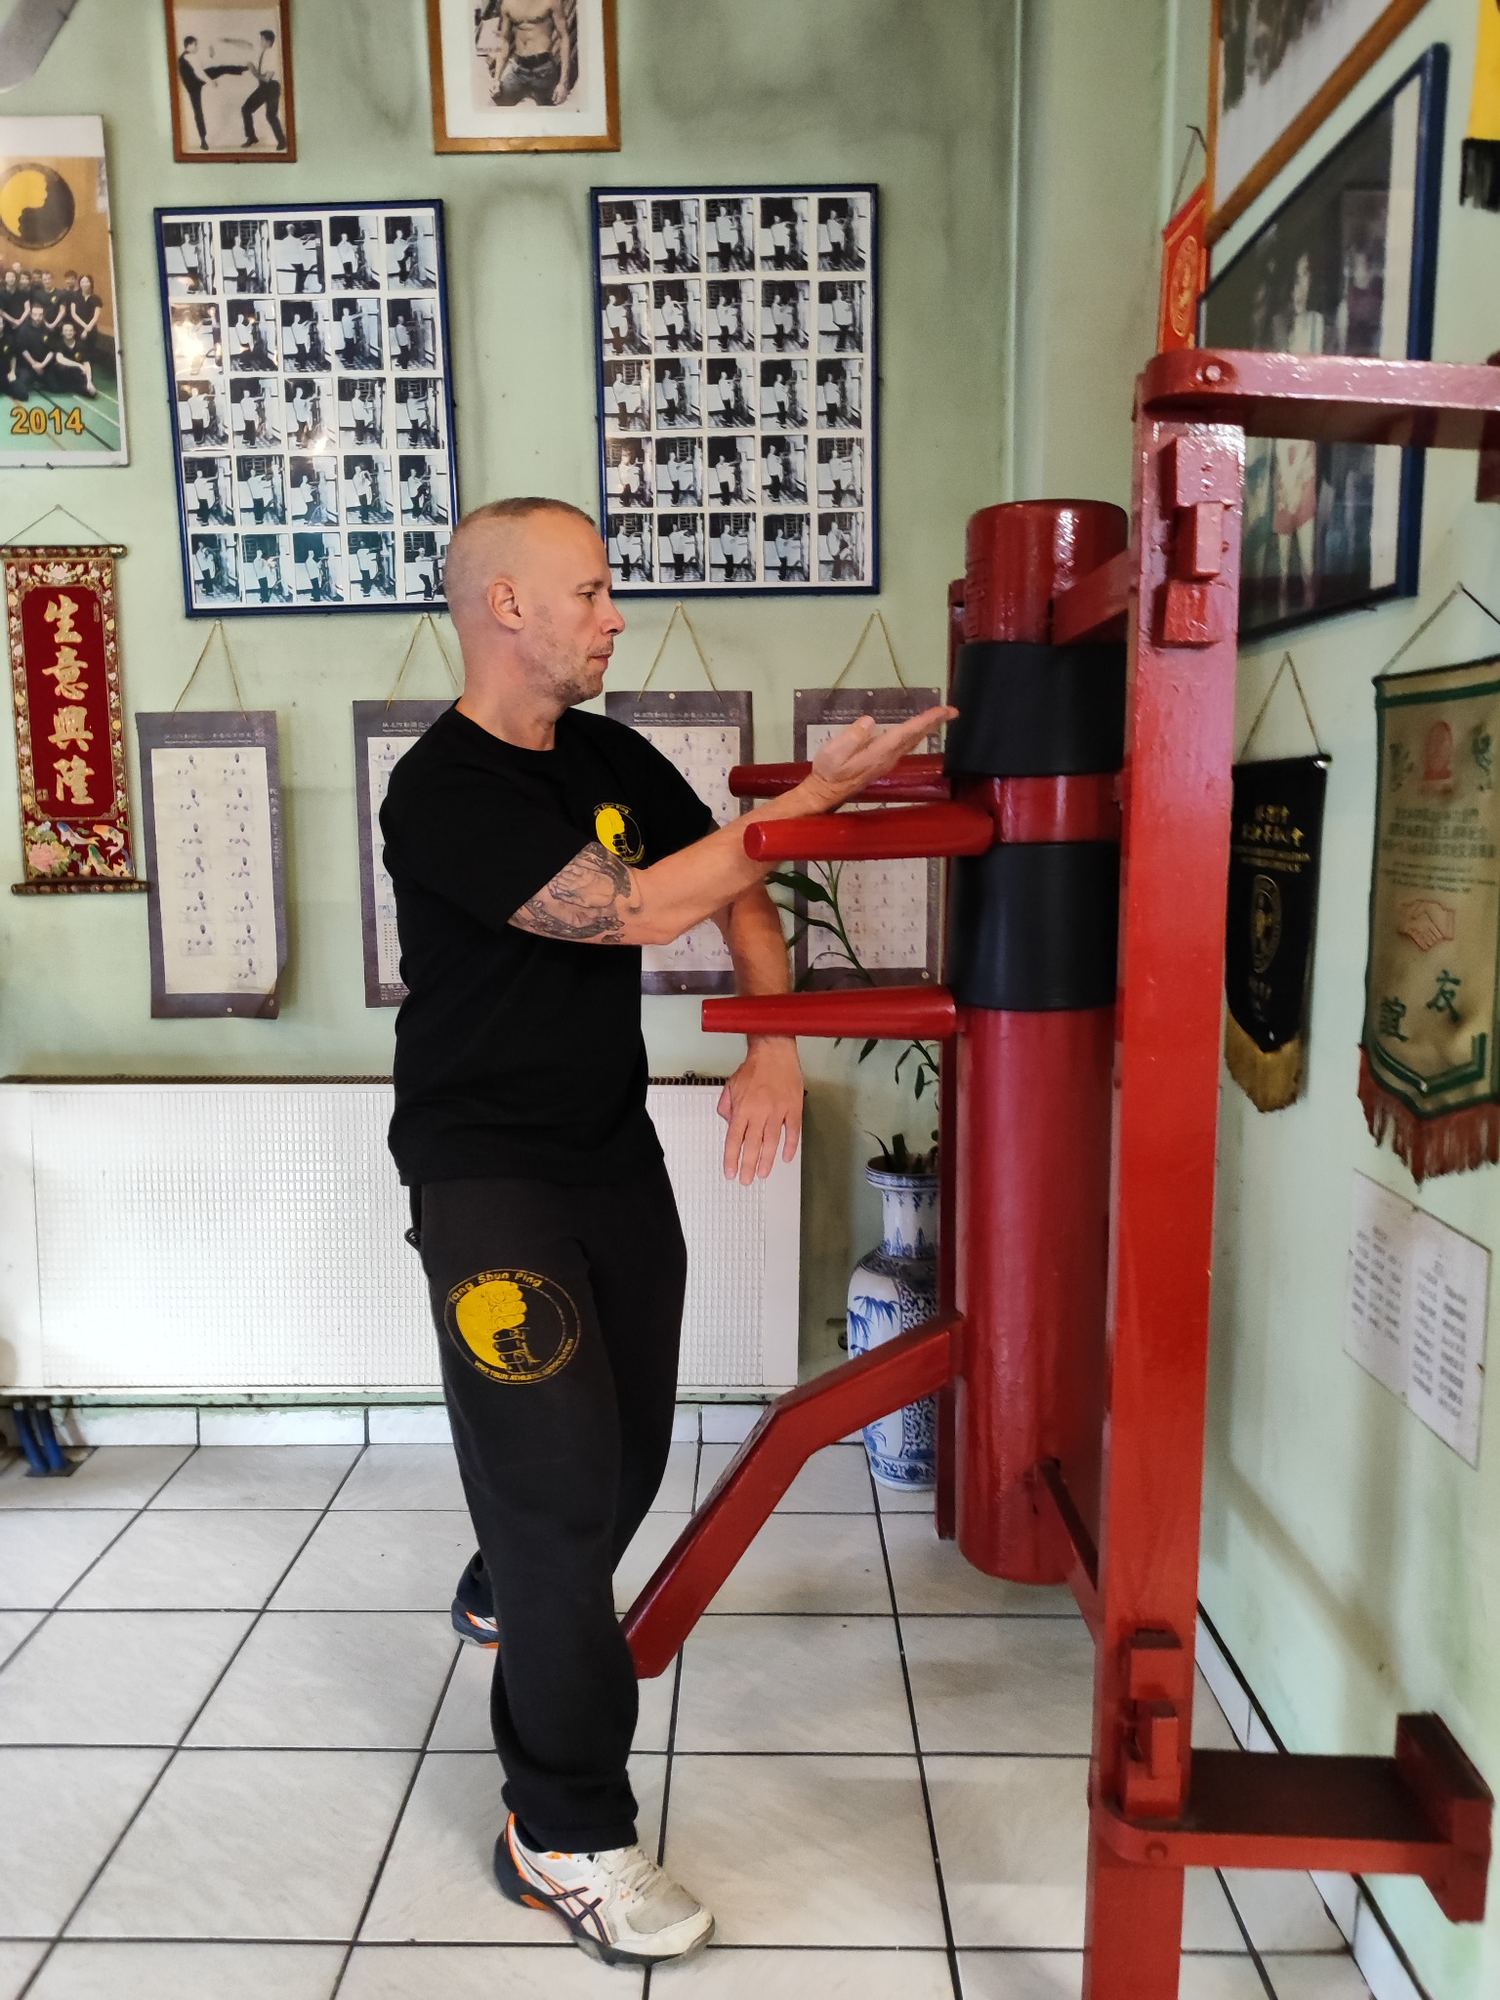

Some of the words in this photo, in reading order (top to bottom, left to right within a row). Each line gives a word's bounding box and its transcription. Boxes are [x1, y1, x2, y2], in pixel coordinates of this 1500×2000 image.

[10, 406, 85, 435] 2014
[42, 593, 95, 804] 生意興隆
[477, 1272, 509, 1284] Shun
[514, 1272, 543, 1288] Ping
